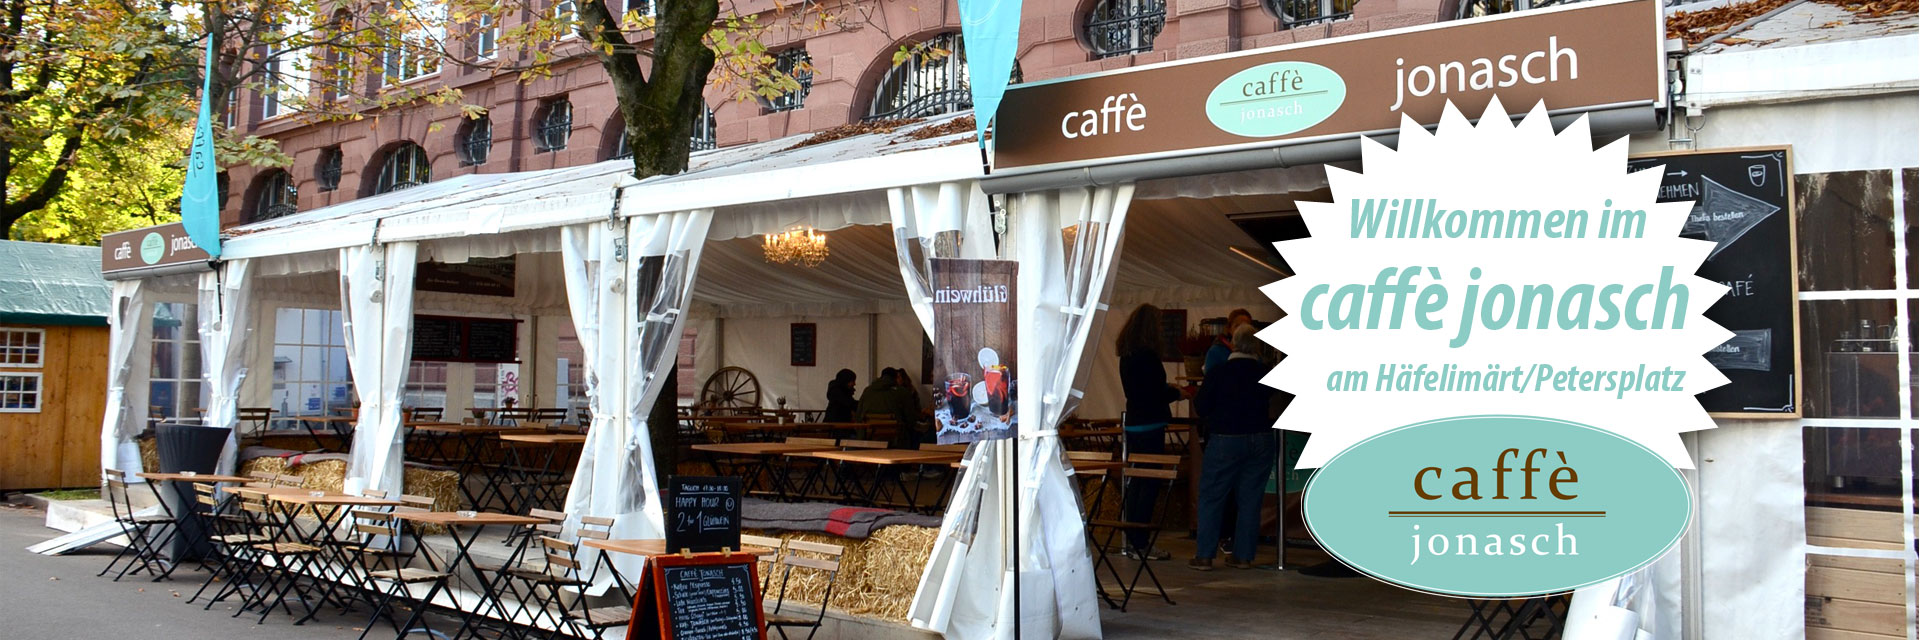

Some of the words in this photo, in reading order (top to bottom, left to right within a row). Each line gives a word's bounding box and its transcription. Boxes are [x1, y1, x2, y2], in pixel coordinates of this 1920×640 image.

[1242, 69, 1304, 97] caffè
[1389, 34, 1580, 112] jonasch
[1061, 93, 1147, 139] caffè
[1239, 100, 1304, 125] jonasch
[114, 241, 132, 261] caffè
[1719, 274, 1755, 297] AFÉ
[675, 496, 698, 508] HAPPY
[701, 496, 720, 508] HOUR
